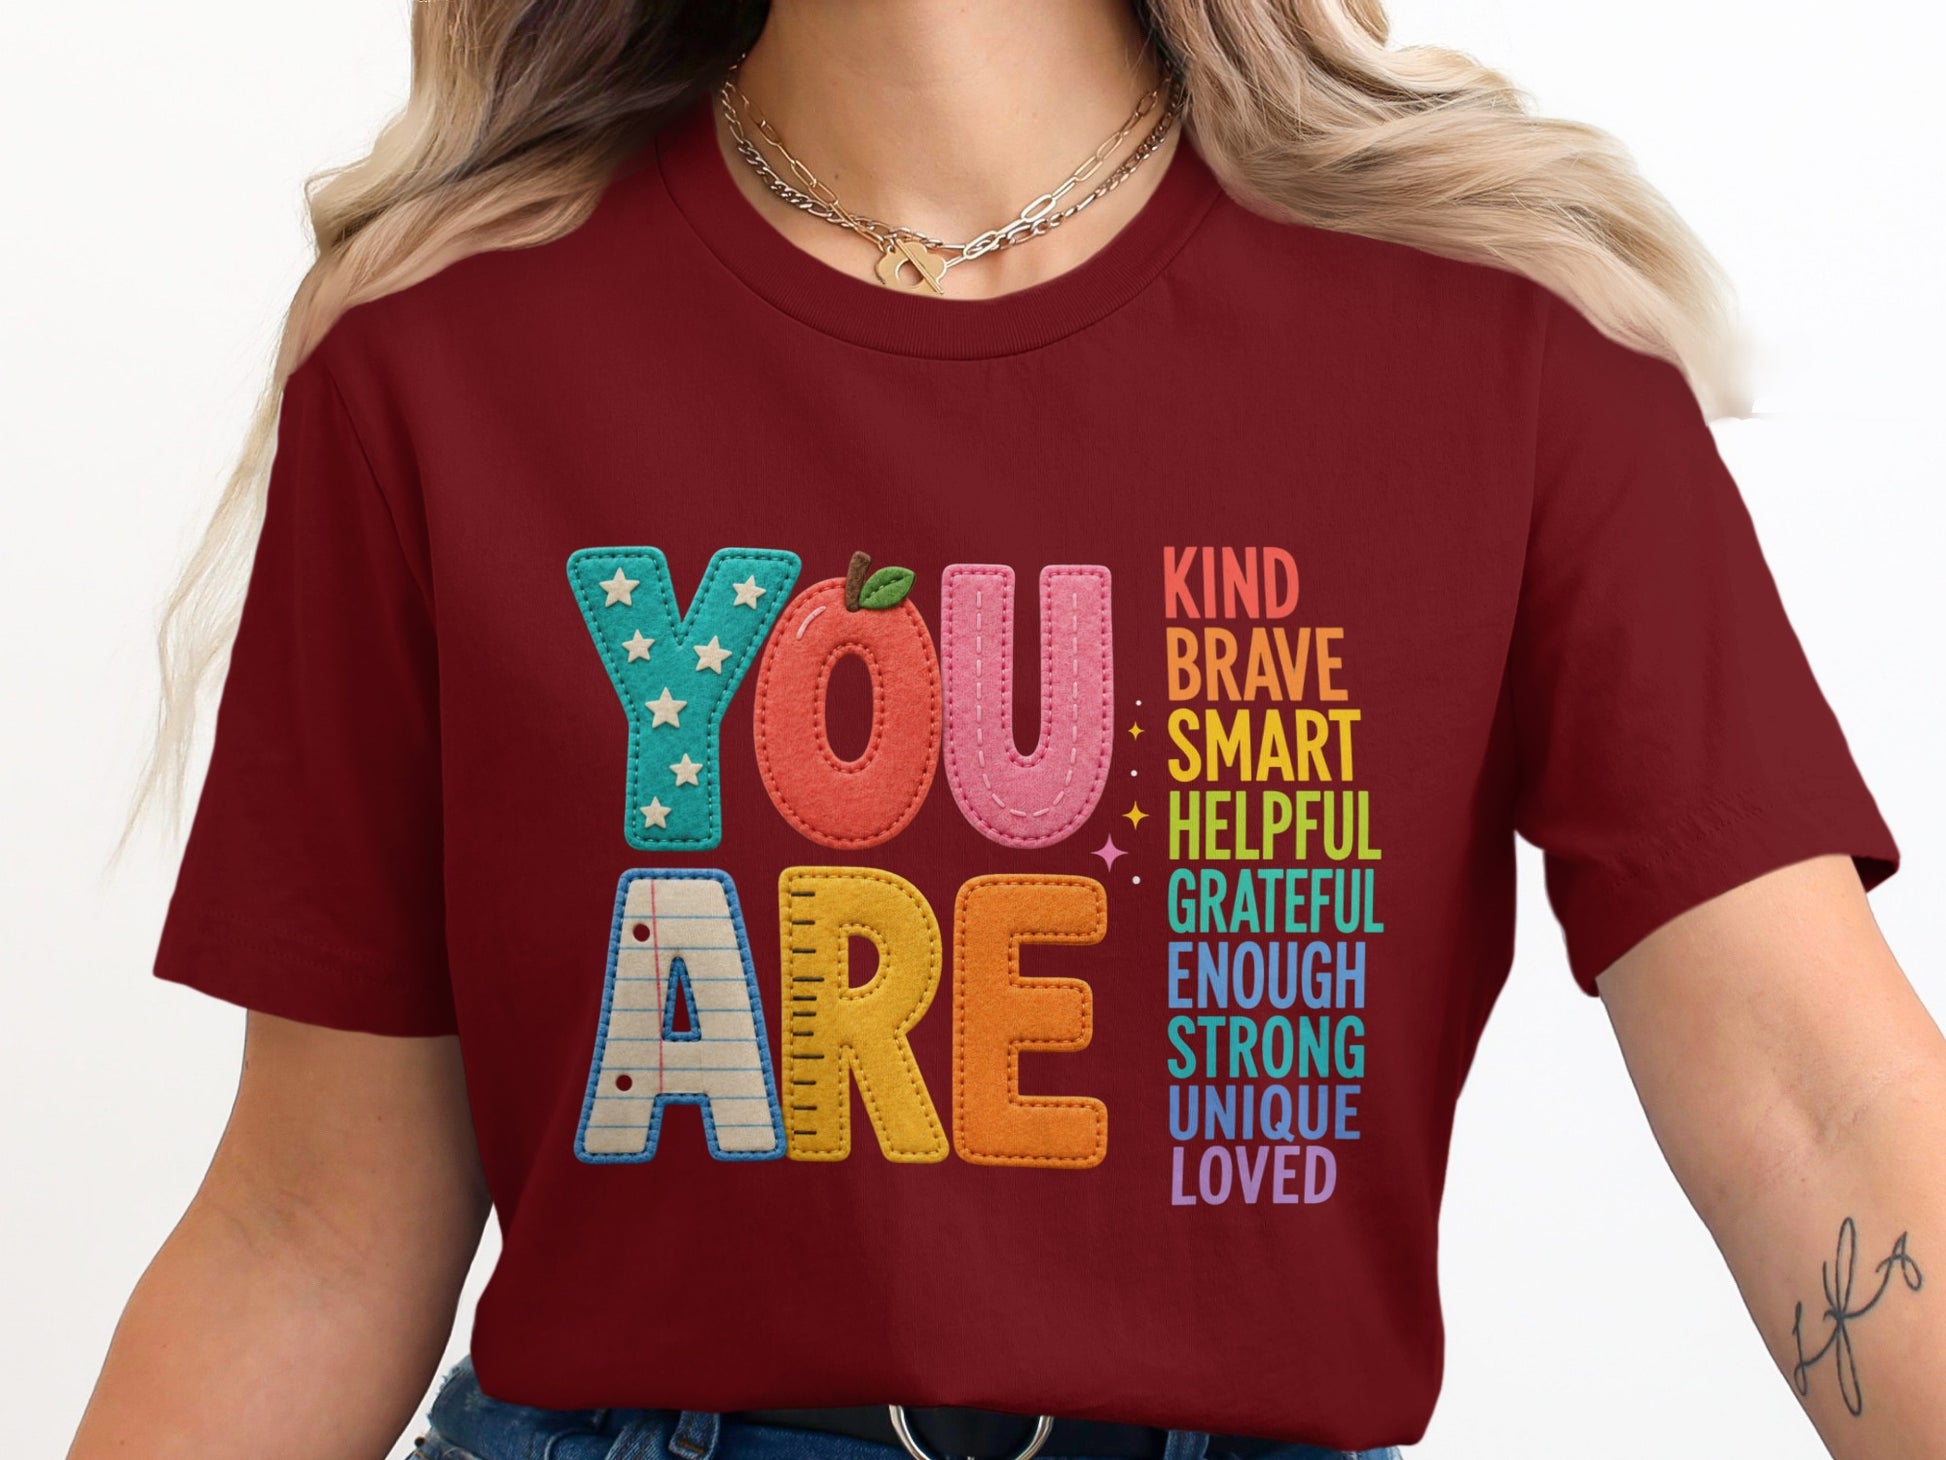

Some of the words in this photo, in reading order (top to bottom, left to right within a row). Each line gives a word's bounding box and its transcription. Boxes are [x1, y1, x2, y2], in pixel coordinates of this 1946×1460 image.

[1163, 545, 1300, 620] KIND
[566, 545, 1115, 851] YOU
[1166, 626, 1348, 702] BRAVE
[1167, 708, 1362, 783] SMART
[1169, 790, 1382, 861] HELPFUL
[1168, 868, 1384, 933] GRATEFUL
[1168, 941, 1366, 1009] ENOUGH
[573, 865, 1109, 1169] ARE
[1167, 1015, 1365, 1079] STRONG
[1169, 1084, 1361, 1142] UNIQUE
[1171, 1145, 1337, 1206] LOVED
